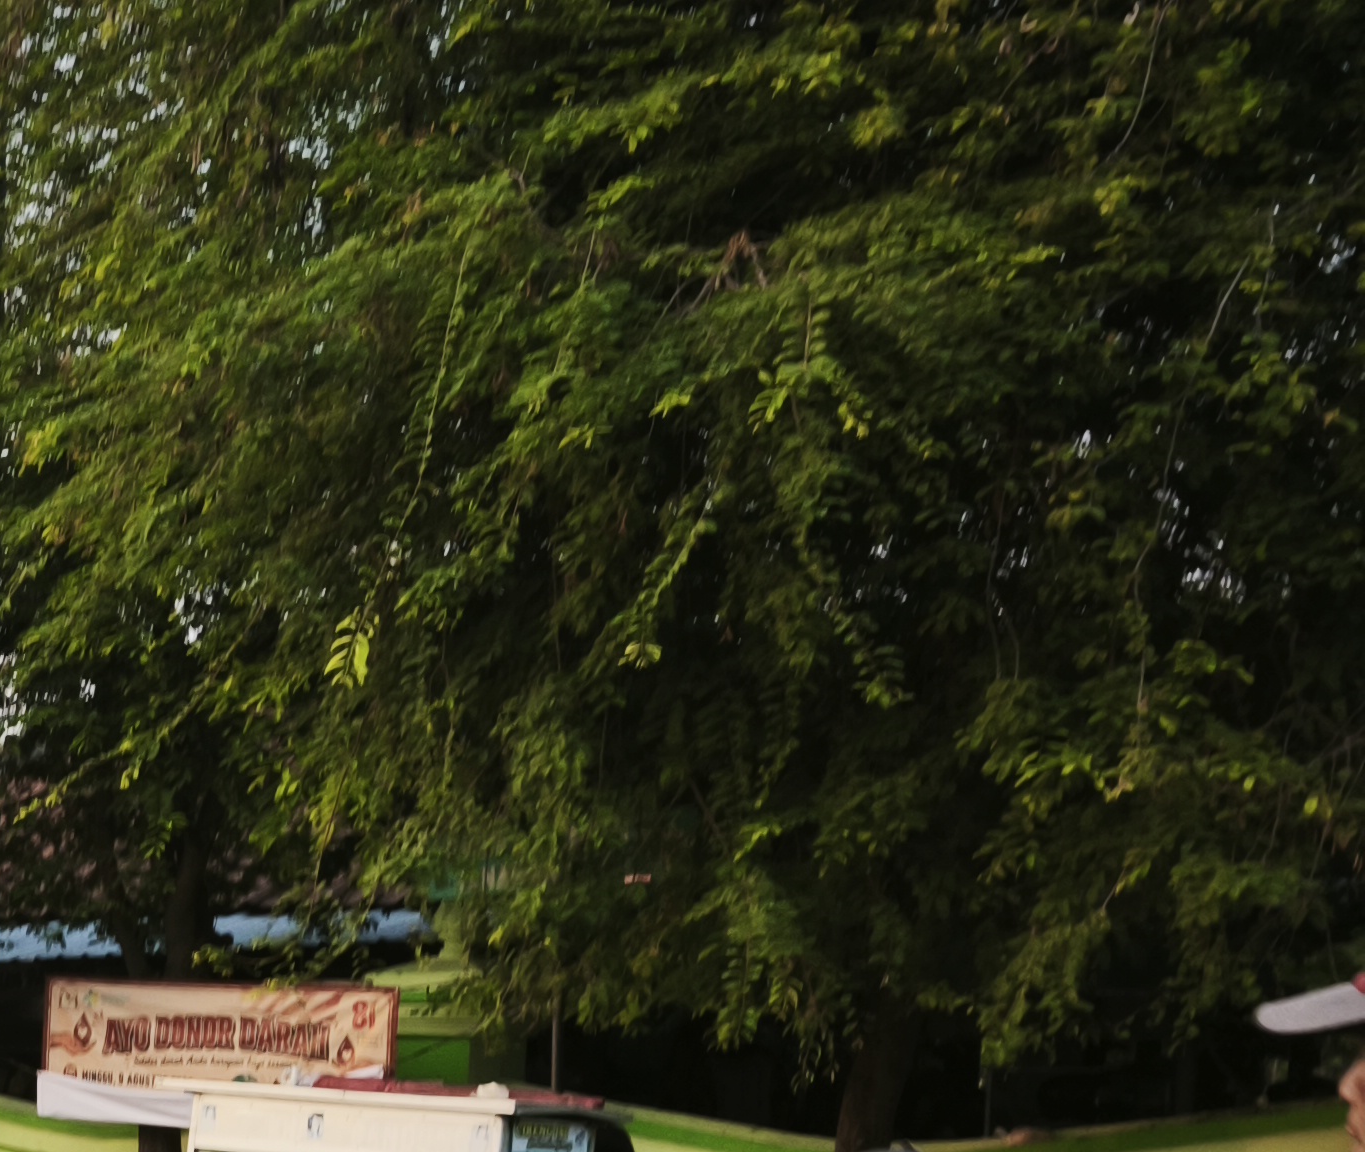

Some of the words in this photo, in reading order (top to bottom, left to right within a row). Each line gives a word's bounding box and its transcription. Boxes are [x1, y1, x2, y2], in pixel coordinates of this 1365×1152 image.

[102, 1017, 151, 1055] AYO
[153, 1013, 236, 1052] DONOR
[238, 1015, 332, 1061] DARAH
